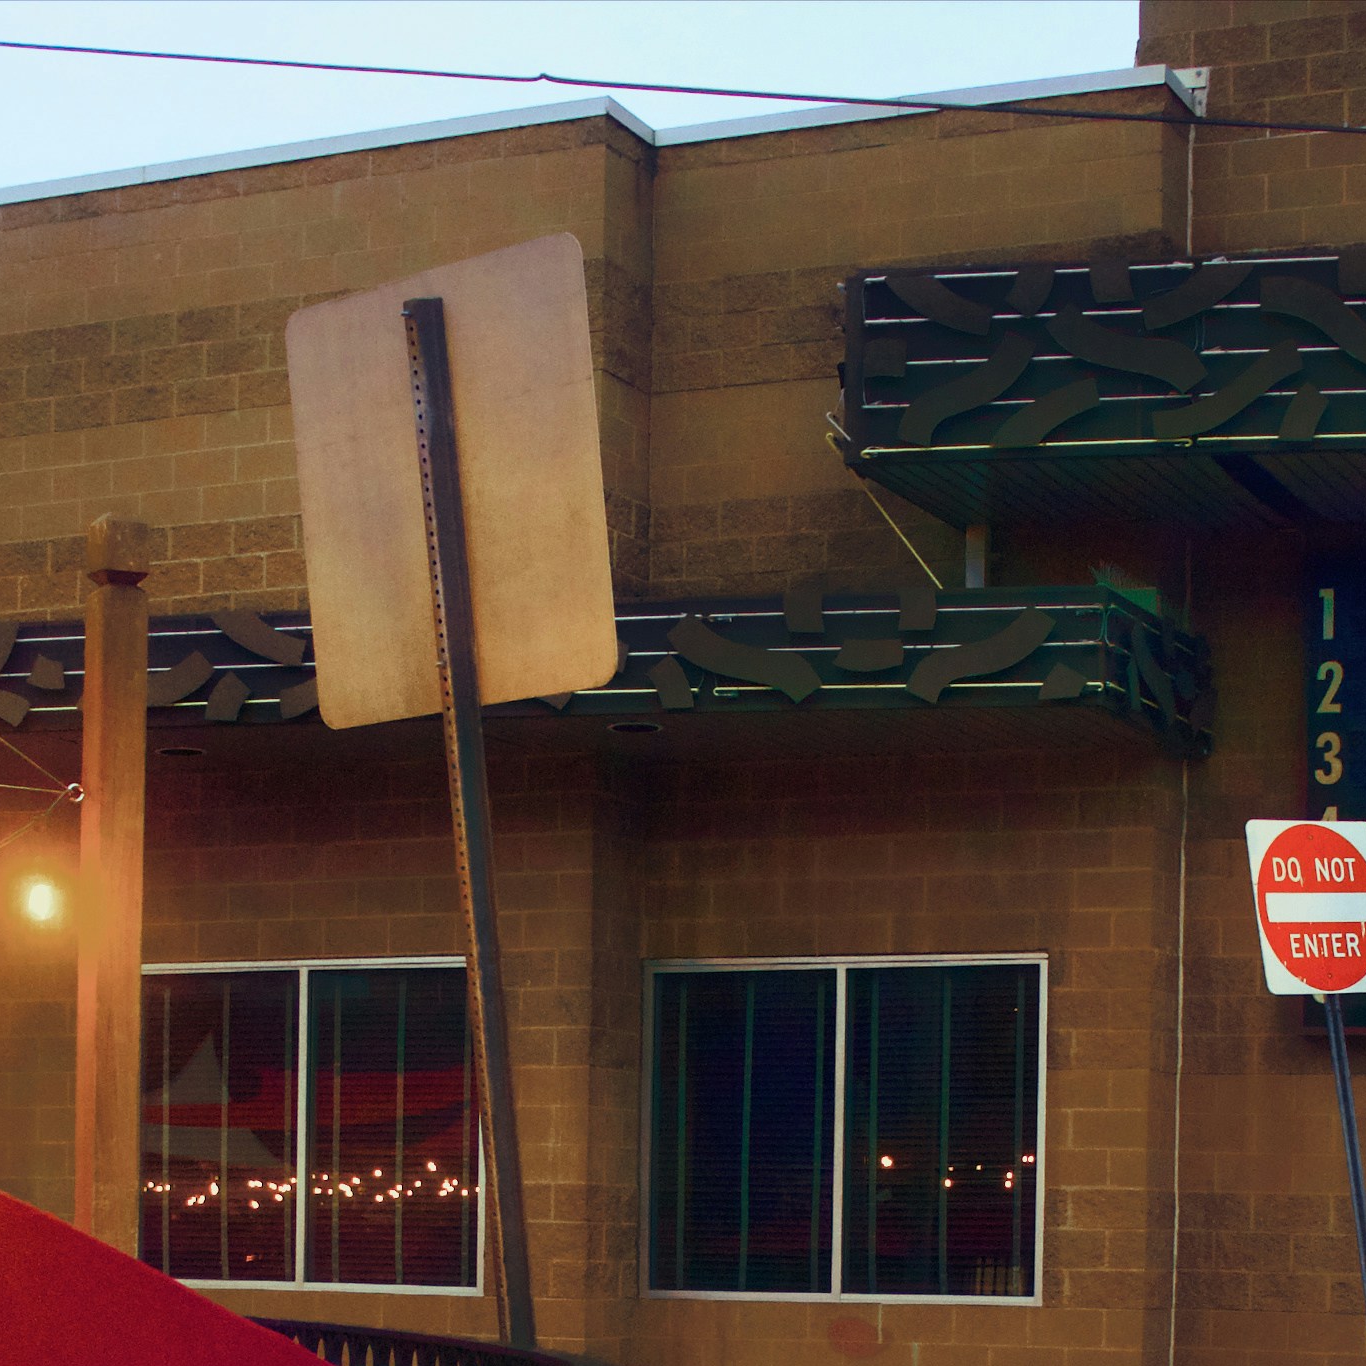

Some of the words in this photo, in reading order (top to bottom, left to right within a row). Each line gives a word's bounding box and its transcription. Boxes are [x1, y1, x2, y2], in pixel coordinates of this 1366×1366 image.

[1318, 588, 1335, 640] 1
[1316, 660, 1343, 714] 2
[1315, 731, 1343, 785] 3
[1272, 857, 1302, 882] DO
[1314, 857, 1356, 882] NOT
[1289, 933, 1362, 958] ENTER
